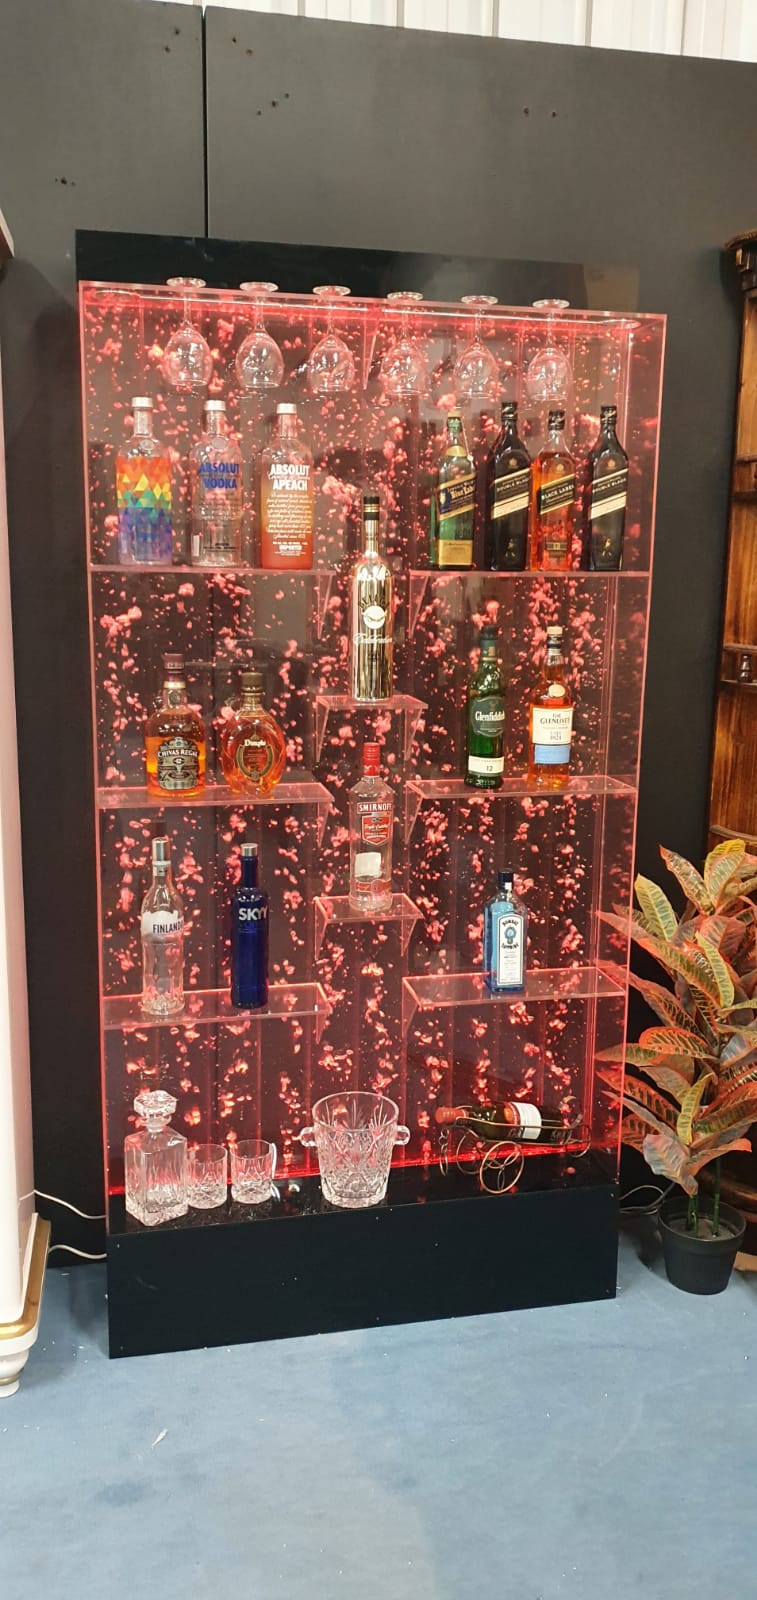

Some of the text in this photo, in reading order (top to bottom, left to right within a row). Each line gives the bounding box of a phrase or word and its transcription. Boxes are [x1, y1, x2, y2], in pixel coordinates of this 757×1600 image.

[199, 463, 240, 474] ABSOLUT
[269, 464, 310, 476] ABSOLUT
[204, 479, 237, 489] VODKA
[273, 480, 308, 491] APEACH
[541, 488, 558, 500] BLACK
[559, 484, 575, 493] LABEL
[244, 739, 267, 748] Dimple
[158, 749, 198, 757] CHIVAS REGAL
[238, 906, 268, 921] SKYY
